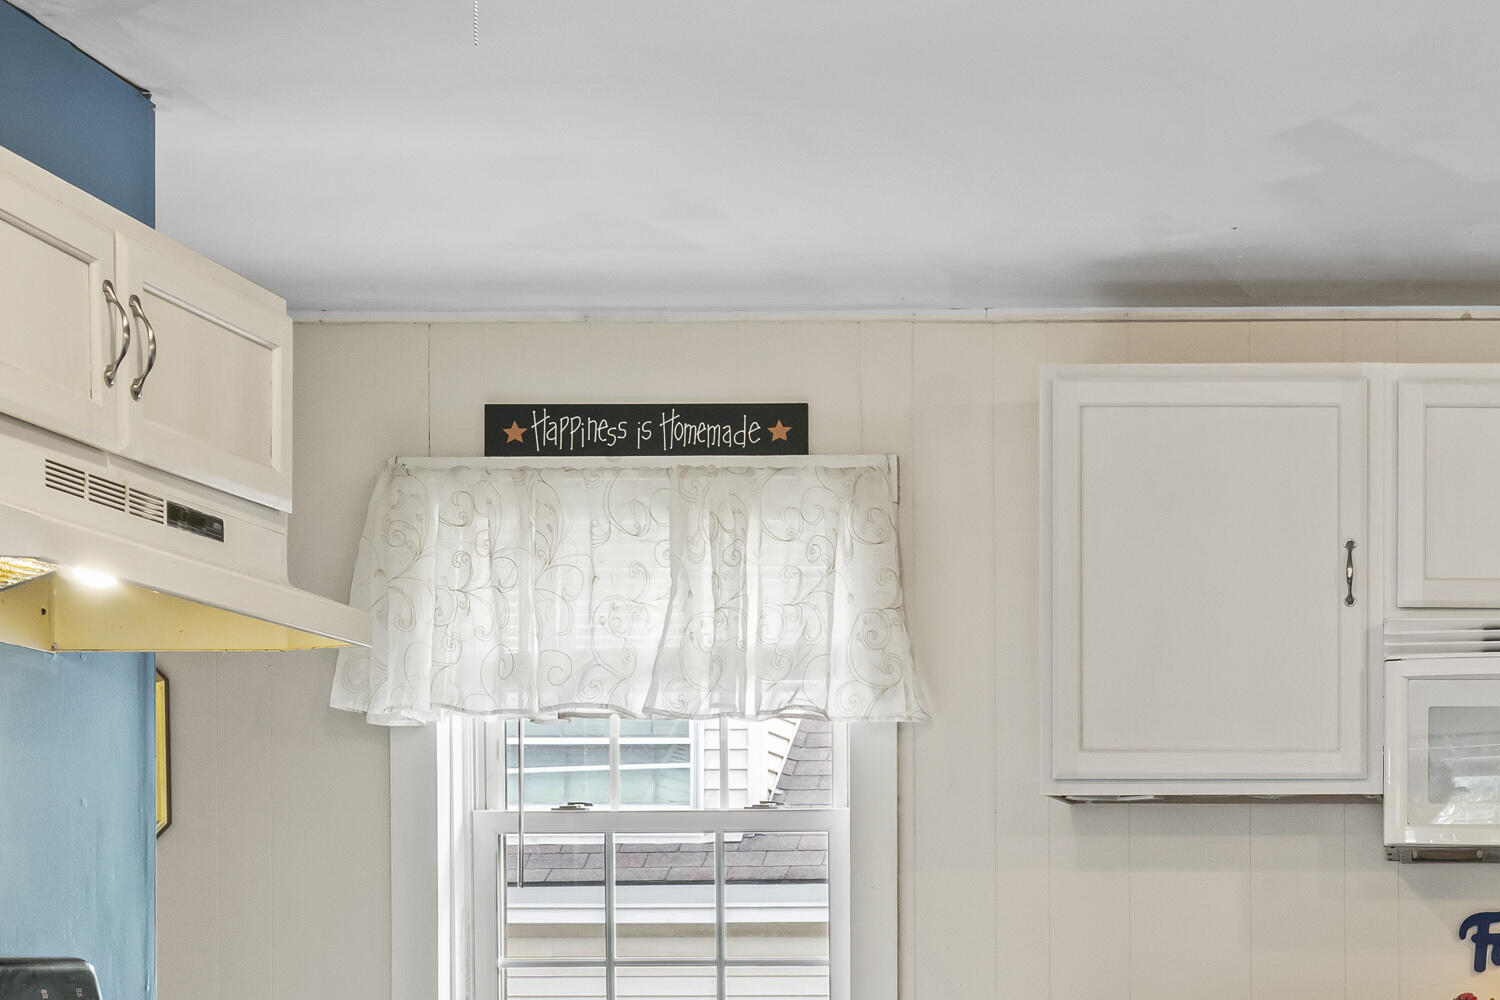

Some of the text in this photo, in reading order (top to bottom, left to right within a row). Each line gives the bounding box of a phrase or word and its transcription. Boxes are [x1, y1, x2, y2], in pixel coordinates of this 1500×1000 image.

[530, 408, 761, 451] Happiness is Homemade
